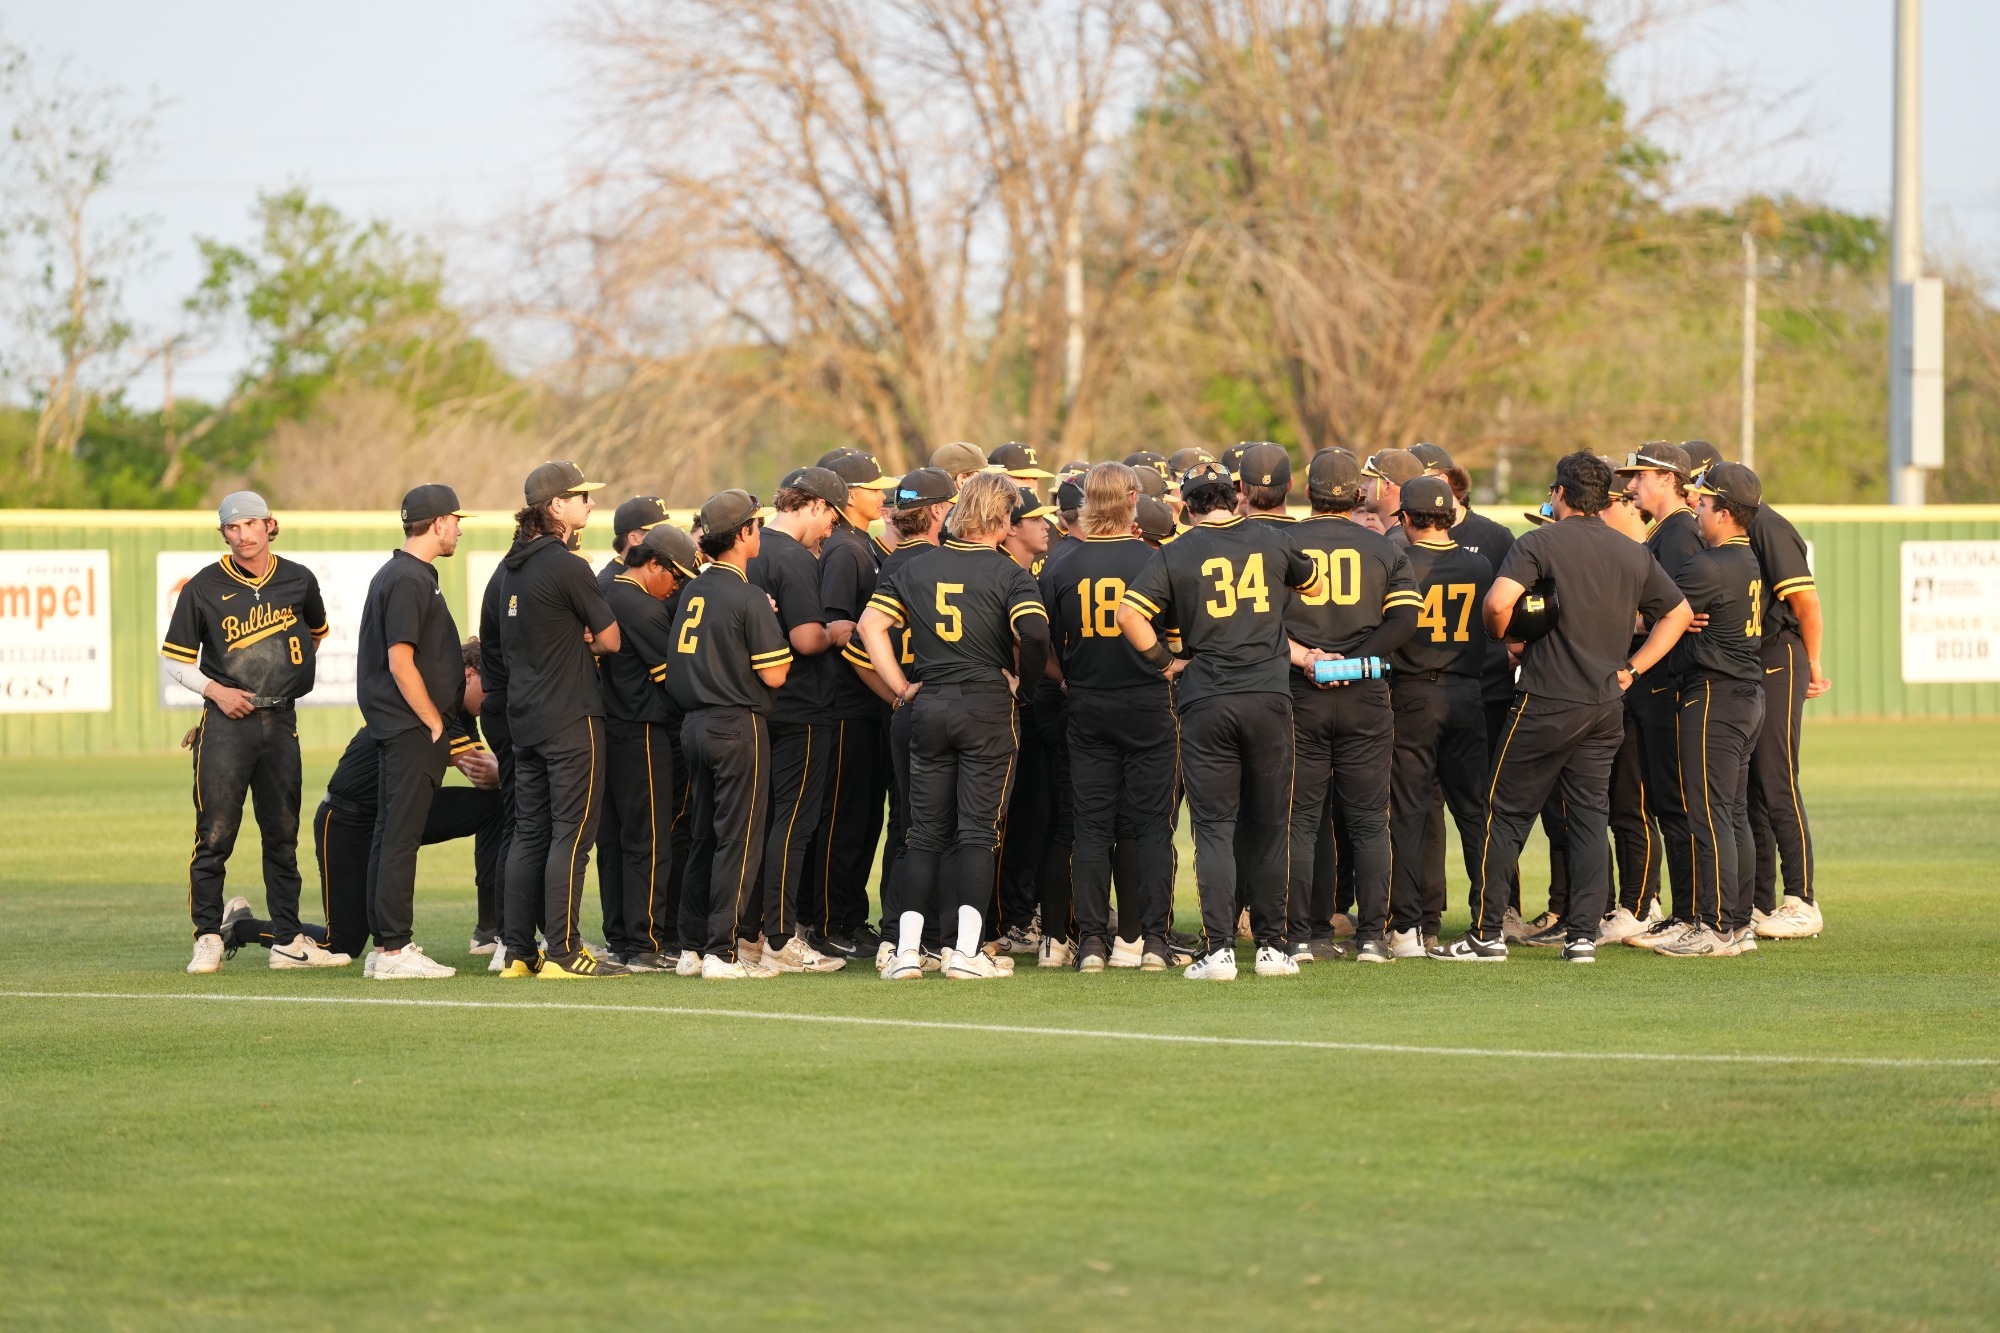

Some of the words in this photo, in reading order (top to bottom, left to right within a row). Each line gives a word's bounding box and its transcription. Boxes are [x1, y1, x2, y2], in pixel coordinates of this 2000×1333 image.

[1024, 448, 1038, 465] T
[1153, 461, 1169, 478] T
[655, 499, 669, 516] T
[1201, 553, 1270, 618] 34
[221, 602, 296, 643] Bulldogs
[677, 596, 706, 655] 2
[935, 582, 964, 642] 5
[1077, 577, 1126, 637] 18
[1416, 583, 1476, 642] 47
[288, 636, 304, 665] 8
[0, 675, 69, 699] GS!
